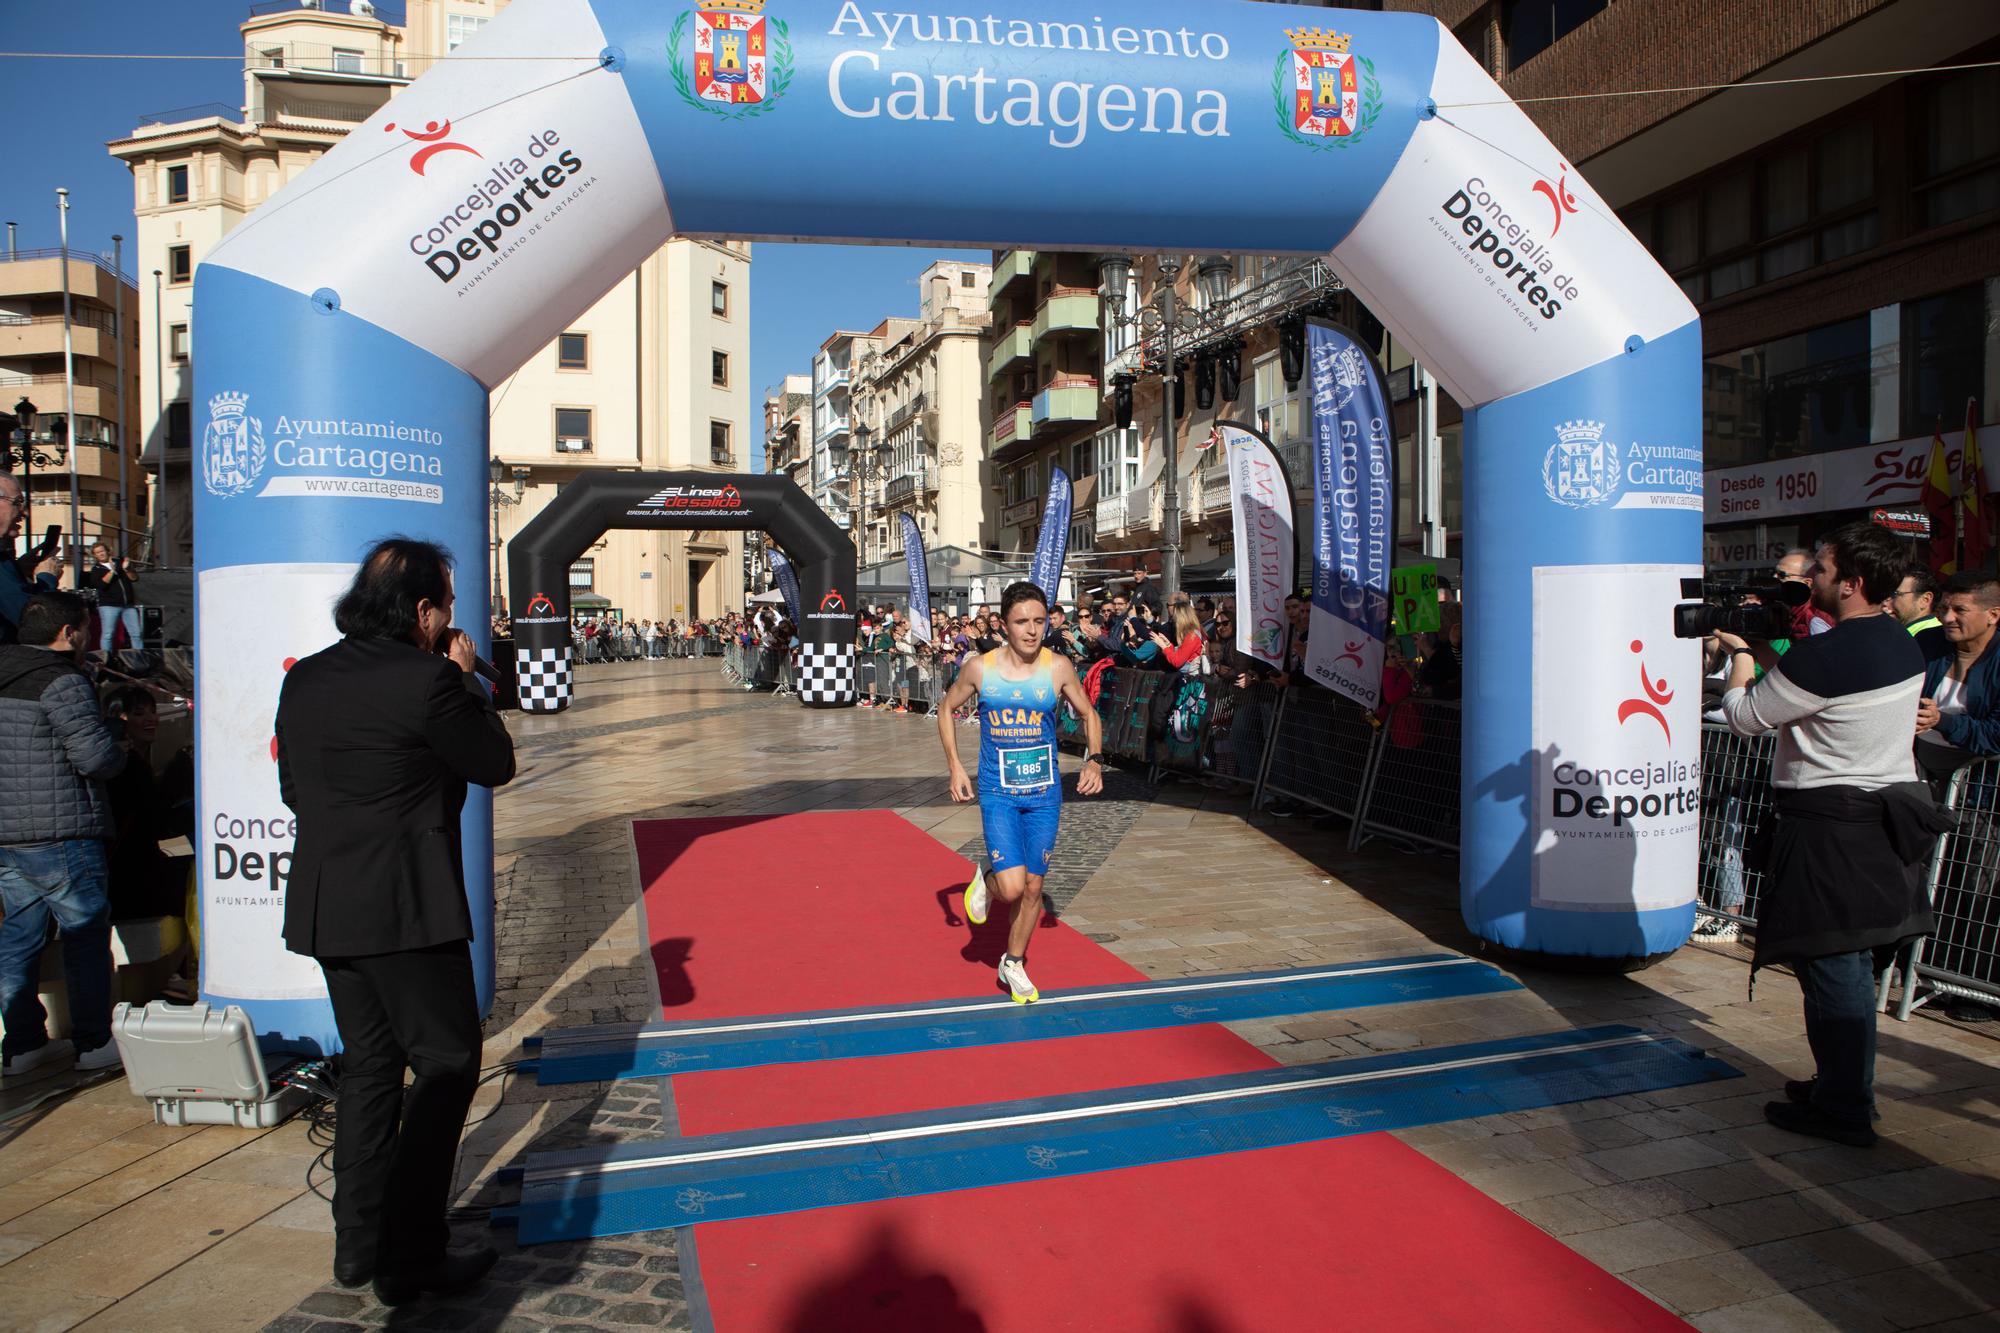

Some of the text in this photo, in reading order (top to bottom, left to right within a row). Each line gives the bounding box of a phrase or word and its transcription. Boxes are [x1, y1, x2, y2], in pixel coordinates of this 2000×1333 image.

[827, 1, 1229, 60] Ayuntamiento
[828, 50, 1230, 148] Cartagena
[410, 130, 560, 255] Concejalía de
[424, 149, 582, 284] Deportes
[457, 176, 597, 297] AYUNTAMIENTO DE CARTAGENA
[1466, 177, 1578, 300] Concejalía de
[1442, 189, 1562, 319] Deportes
[1428, 216, 1538, 332] AYUNTAMIENTO DE CARTAGENA
[274, 415, 442, 446] Ayuntamiento
[274, 440, 443, 477] Cartagena
[305, 480, 439, 499] www.cartagena.es
[1721, 471, 1817, 501] Desde 1950
[1721, 498, 1760, 514] Since
[988, 708, 1044, 726] UCAM
[990, 727, 1042, 737] UNIVERSIDAD
[1016, 762, 1041, 775] 1885
[1553, 761, 1686, 790] Concejalía
[1554, 830, 1648, 839] AYUNTAMIENTO
[1653, 829, 1665, 837] DE
[215, 843, 293, 891] Dep
[215, 897, 284, 906] AYUNTAMIE
